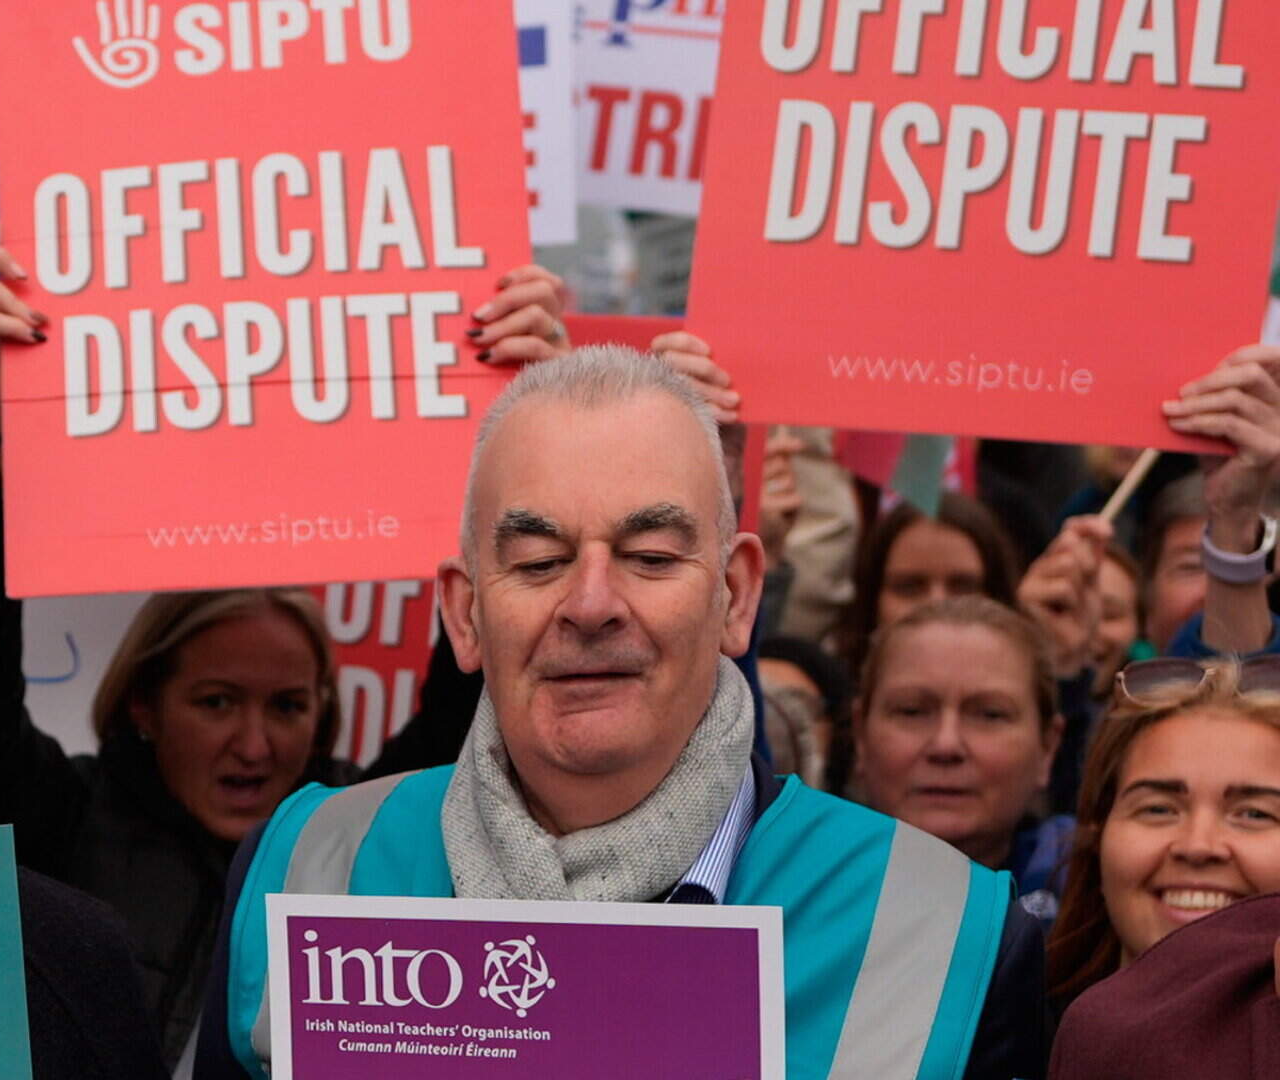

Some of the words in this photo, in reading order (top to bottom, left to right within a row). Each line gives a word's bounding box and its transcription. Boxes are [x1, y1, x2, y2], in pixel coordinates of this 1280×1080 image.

[174, 0, 412, 75] SIPTU
[586, 84, 712, 181] TRI
[764, 98, 1207, 263] DISPUTE
[34, 145, 485, 295] OFFICIAL
[63, 290, 468, 438] DISPUTE
[828, 350, 1095, 394] www.siptu.ie
[146, 510, 400, 549] www.siptu.ie
[302, 929, 463, 1009] into
[305, 1019, 335, 1032] Irish
[338, 1020, 394, 1034] National
[396, 1022, 459, 1037] Teachers'
[461, 1025, 551, 1042] Organisation
[339, 1039, 392, 1053] Cumann
[394, 1041, 464, 1057] Múinteoirí
[466, 1042, 517, 1059] Éireann
